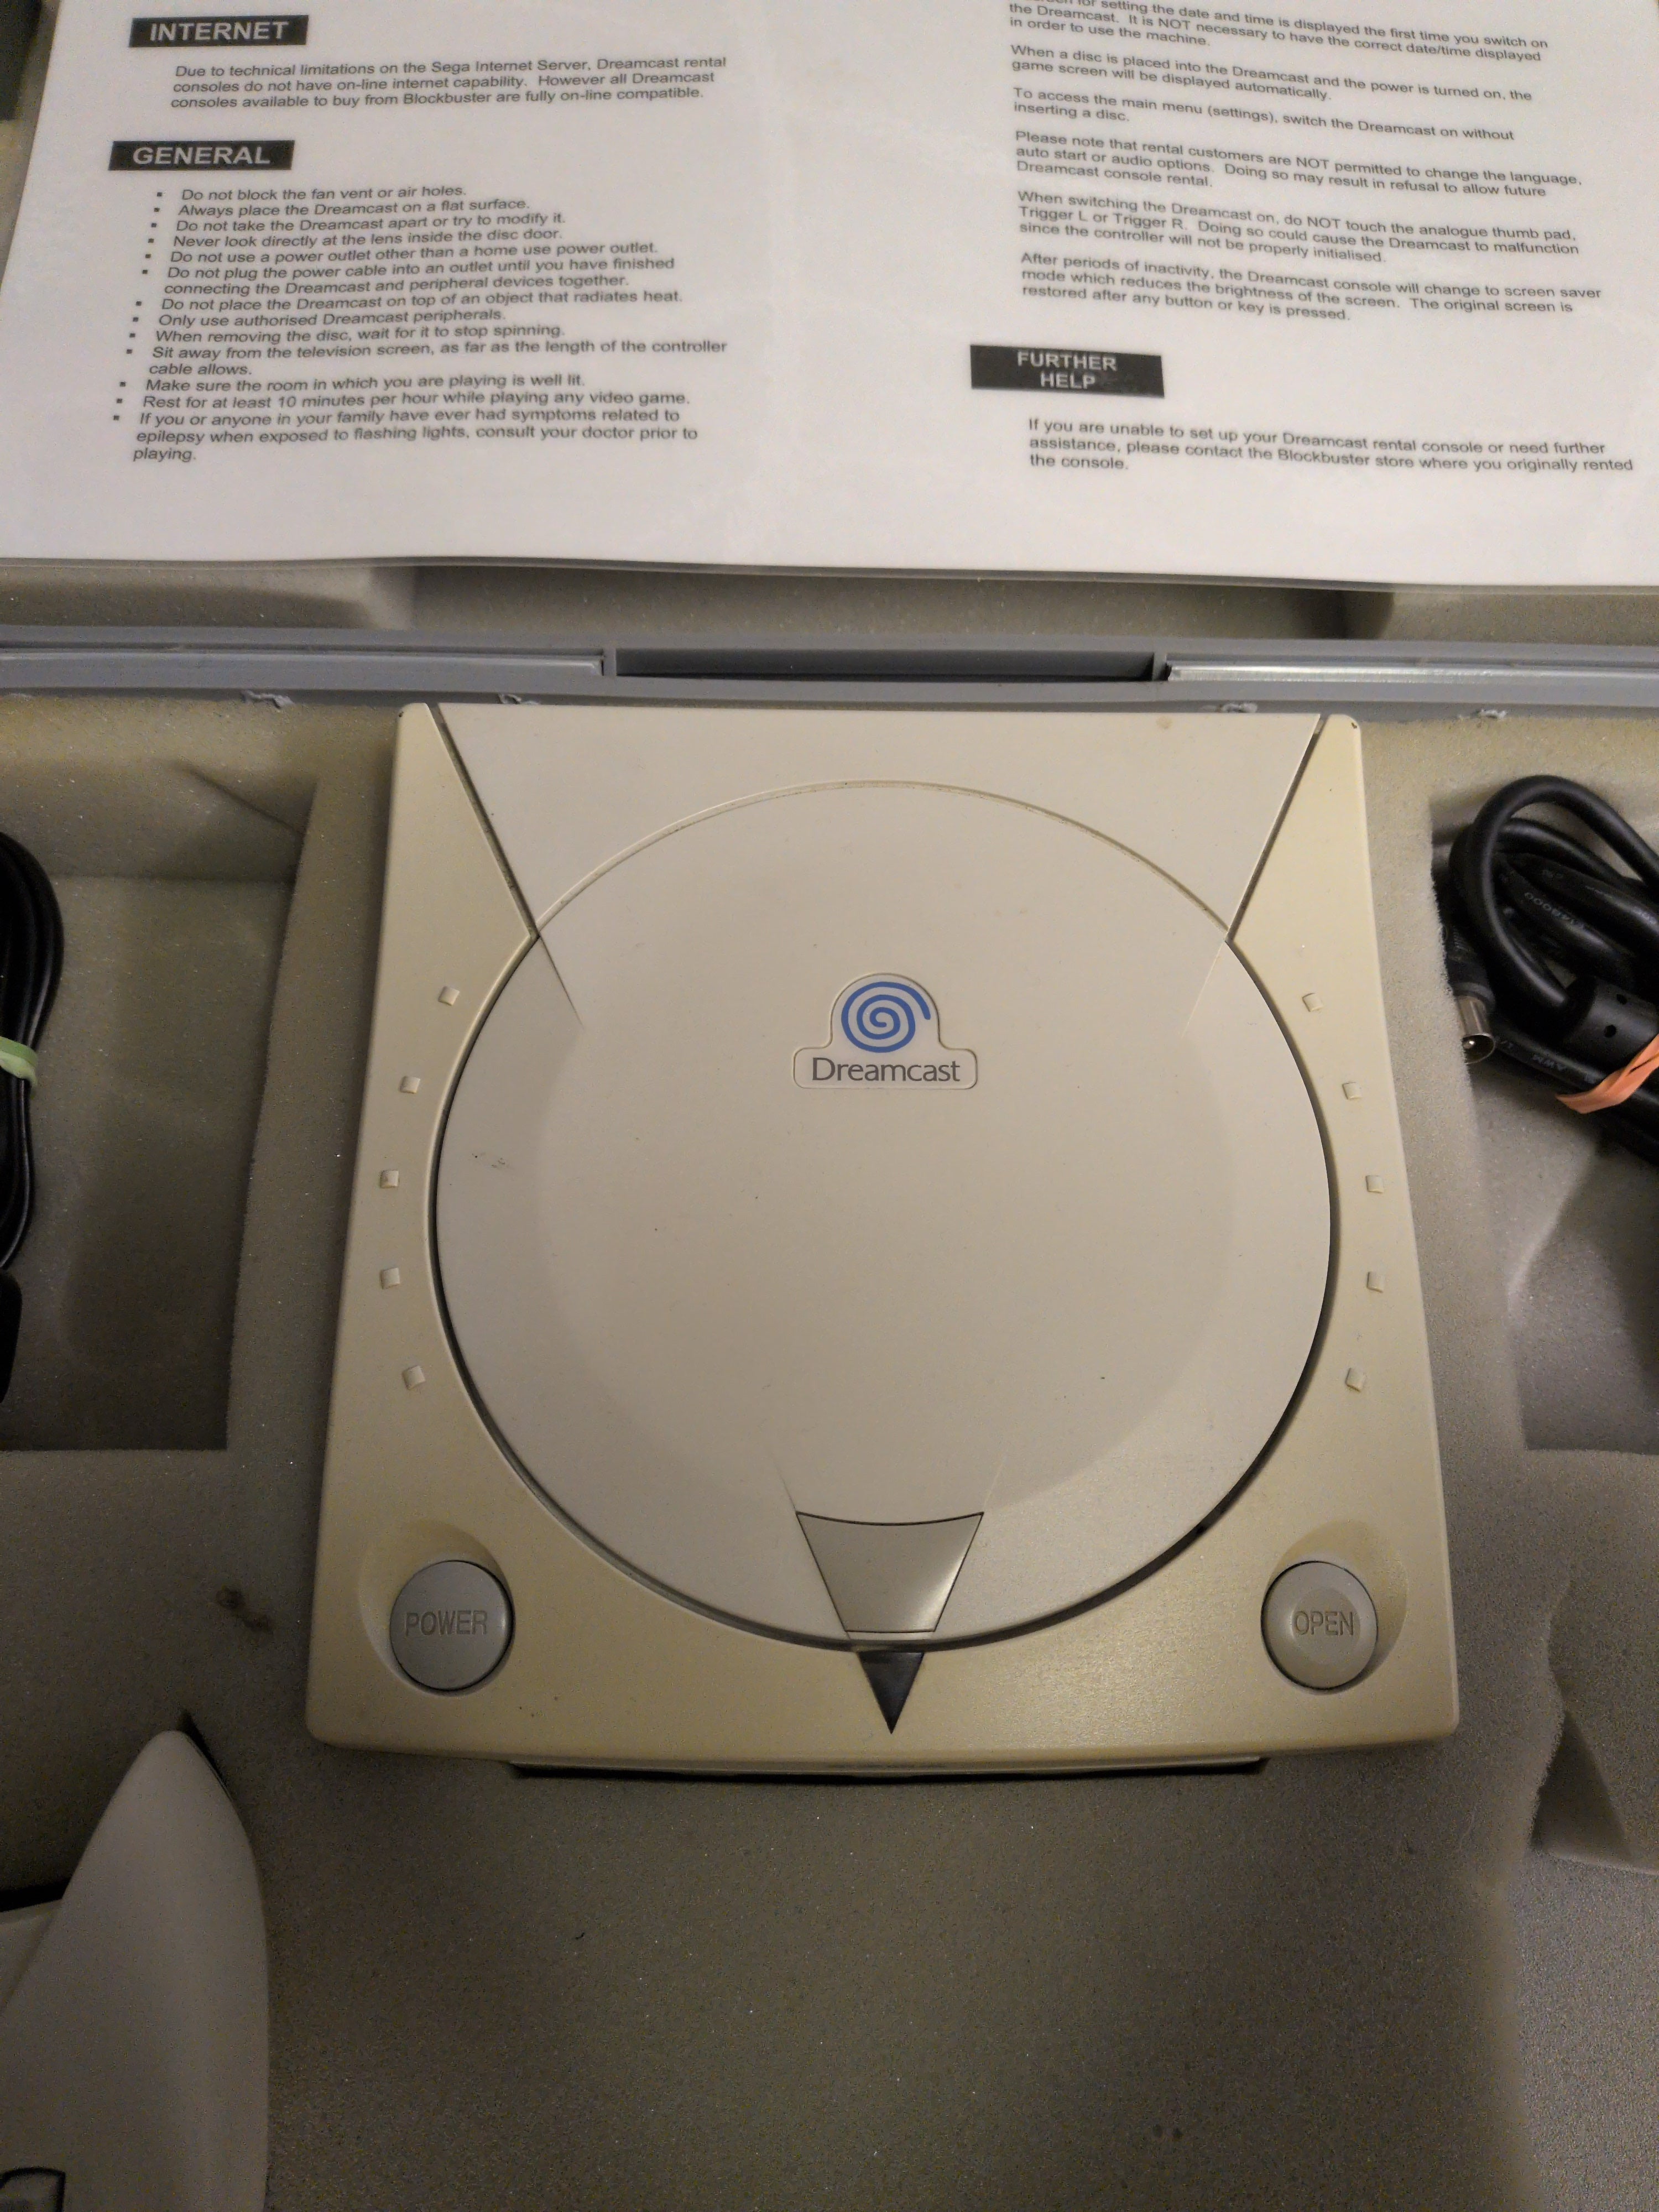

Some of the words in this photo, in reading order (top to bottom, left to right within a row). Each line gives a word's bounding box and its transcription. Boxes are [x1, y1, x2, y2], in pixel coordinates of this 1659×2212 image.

[149, 21, 289, 41] INTERNET
[175, 65, 207, 77] Due
[211, 66, 226, 77] to
[229, 64, 296, 77] technical
[300, 64, 375, 76] limitations
[379, 64, 399, 74] on
[403, 62, 427, 74] the
[431, 61, 471, 75] Sega
[475, 60, 533, 72] Internet
[537, 59, 591, 71] Server,
[597, 58, 680, 70] Dreamcast
[684, 56, 727, 68] rental
[1011, 61, 1054, 72] game
[1058, 64, 1108, 77] screen
[1112, 69, 1135, 80] will
[1139, 70, 1158, 82] be
[1162, 73, 1230, 90] displayed
[1235, 82, 1331, 102] automatically.
[170, 96, 238, 108] consoles
[242, 95, 309, 108] available
[313, 96, 328, 107] to
[332, 95, 360, 108] buy
[364, 94, 399, 106] from
[403, 92, 492, 105] Blockbuster
[496, 93, 521, 102] are
[525, 90, 556, 105] fully
[559, 89, 612, 101] on-line
[616, 86, 703, 101] compatible.
[1013, 87, 1033, 98] To
[1037, 91, 1089, 104] access
[1093, 94, 1117, 106] the
[1121, 98, 1157, 110] main
[1162, 102, 1203, 114] menu
[1207, 105, 1278, 124] (settings),
[1282, 114, 1327, 127] switch
[1330, 118, 1354, 130] the
[1358, 120, 1436, 136] Dreamcast
[1439, 128, 1458, 137] on
[1462, 128, 1515, 140] without
[1014, 102, 1078, 119] inserting
[1082, 109, 1092, 118] a
[1095, 108, 1130, 122] disc.
[133, 146, 271, 165] GENERAL
[1016, 159, 1099, 178] Dreamcast
[1104, 169, 1162, 182] console
[1166, 174, 1212, 187] rental.
[178, 204, 234, 219] Always
[238, 205, 280, 218] place
[284, 204, 309, 216] the
[314, 202, 398, 215] Dreamcast
[401, 203, 421, 213] on
[426, 202, 436, 212] a
[441, 200, 465, 211] flat
[468, 198, 529, 211] surface.
[1017, 190, 1063, 204] When
[1068, 196, 1138, 213] switching
[1142, 200, 1166, 213] the
[1171, 202, 1252, 221] Dreamcast
[1256, 213, 1279, 225] on,
[1284, 214, 1303, 226] do
[1307, 216, 1341, 229] NOT
[1345, 220, 1387, 232] touch
[1390, 222, 1414, 234] the
[1418, 225, 1489, 239] analogue
[1491, 226, 1540, 239] thumb
[1543, 229, 1576, 242] pad,
[173, 235, 221, 247] Never
[224, 236, 258, 247] look
[261, 234, 318, 249] directly
[321, 234, 338, 247] at
[341, 234, 366, 246] the
[370, 233, 403, 245] lens
[407, 231, 453, 243] inside
[457, 230, 483, 242] the
[486, 229, 519, 241] disc
[523, 228, 562, 239] door.
[1019, 222, 1060, 235] since
[1064, 225, 1089, 237] the
[1094, 229, 1165, 243] controller
[1168, 234, 1193, 246] will
[1197, 237, 1221, 248] not
[1225, 238, 1245, 251] be
[1248, 242, 1309, 259] properly
[1313, 247, 1386, 263] initialised.
[164, 283, 251, 298] connecting
[255, 283, 280, 295] the
[284, 281, 371, 294] Dreamcast
[374, 280, 405, 291] and
[409, 276, 489, 293] peripheral
[492, 275, 554, 288] devices
[558, 274, 628, 289] together.
[1022, 285, 1087, 299] restored
[1092, 288, 1128, 302] after
[1132, 294, 1160, 307] any
[1165, 294, 1213, 309] button
[1218, 301, 1233, 310] or
[1238, 300, 1265, 316] key
[1269, 303, 1281, 315] is
[1286, 306, 1350, 321] pressed.
[158, 314, 196, 329] Only
[200, 316, 230, 326] use
[233, 314, 318, 327] authorised
[322, 311, 409, 326] Dreamcast
[413, 308, 505, 324] peripherals.
[152, 346, 174, 359] Sit
[178, 349, 221, 362] away
[226, 347, 262, 359] from
[267, 347, 292, 358] the
[296, 345, 372, 358] television
[376, 345, 434, 356] screen,
[440, 343, 460, 354] as
[464, 341, 487, 353] far
[490, 343, 509, 353] as
[514, 340, 540, 352] the
[545, 340, 595, 355] length
[599, 340, 617, 352] of
[620, 340, 646, 352] the
[651, 340, 727, 353] controller
[1016, 350, 1118, 372] FURTHER
[148, 363, 193, 375] cable
[197, 363, 252, 375] allows.
[1040, 372, 1097, 390] HELP
[136, 429, 206, 446] epilepsy
[210, 430, 254, 444] when
[258, 429, 329, 445] exposed
[333, 429, 349, 441] to
[354, 426, 418, 441] flashing
[422, 425, 469, 441] lights,
[476, 425, 536, 438] consult
[540, 427, 578, 441] your
[582, 425, 635, 439] doctor
[640, 427, 678, 442] prior
[682, 427, 698, 440] to
[133, 447, 196, 463] playing.
[1029, 437, 1121, 453] assistance,
[1126, 440, 1180, 455] please
[1185, 445, 1243, 458] contact
[1248, 447, 1273, 460] the
[1277, 447, 1370, 466] Blockbuster
[1375, 455, 1415, 468] store
[1418, 457, 1468, 469] where
[1473, 460, 1503, 472] you
[1506, 458, 1578, 473] originally
[1583, 459, 1634, 471] rented
[1030, 453, 1056, 467] the
[1061, 456, 1128, 469] console.
[812, 1057, 961, 1082] Dreamcast
[405, 1610, 488, 1637] POWER
[1295, 1610, 1354, 1636] OPEN
